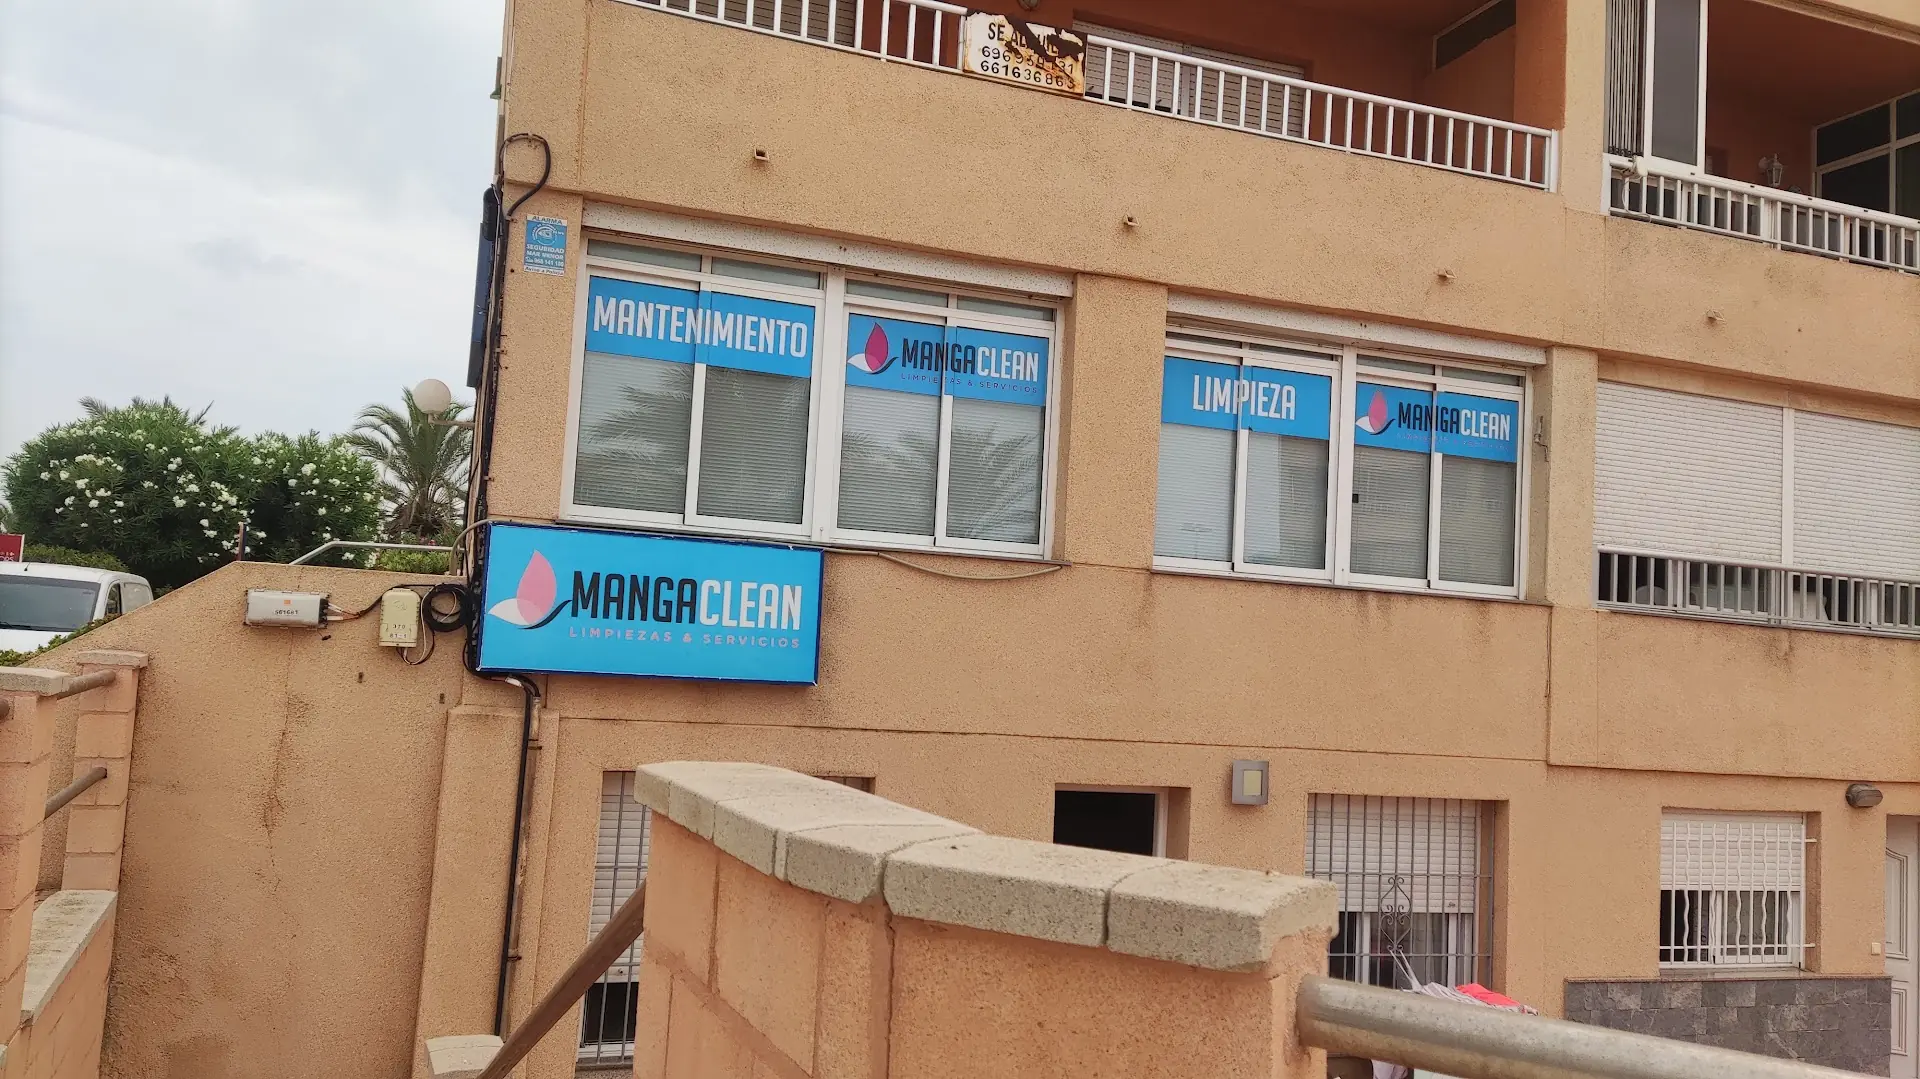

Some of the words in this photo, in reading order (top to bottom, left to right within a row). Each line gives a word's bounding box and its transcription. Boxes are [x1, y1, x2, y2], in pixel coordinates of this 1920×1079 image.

[988, 22, 1006, 41] SE
[531, 215, 563, 225] ALARMA
[526, 244, 565, 254] SEGURIDAD
[593, 295, 808, 358] MANTENIMIENTO
[902, 338, 1039, 382] MANGACLEAN
[979, 381, 1039, 394] SERVICIOS
[1192, 374, 1296, 420] LIMPIEZA
[1397, 401, 1511, 441] MANGACLEAN
[571, 570, 803, 631] MANGACLEAN
[569, 626, 673, 643] LIMPIEZAS
[682, 633, 692, 643] &
[702, 633, 801, 649] SERVICIOS
